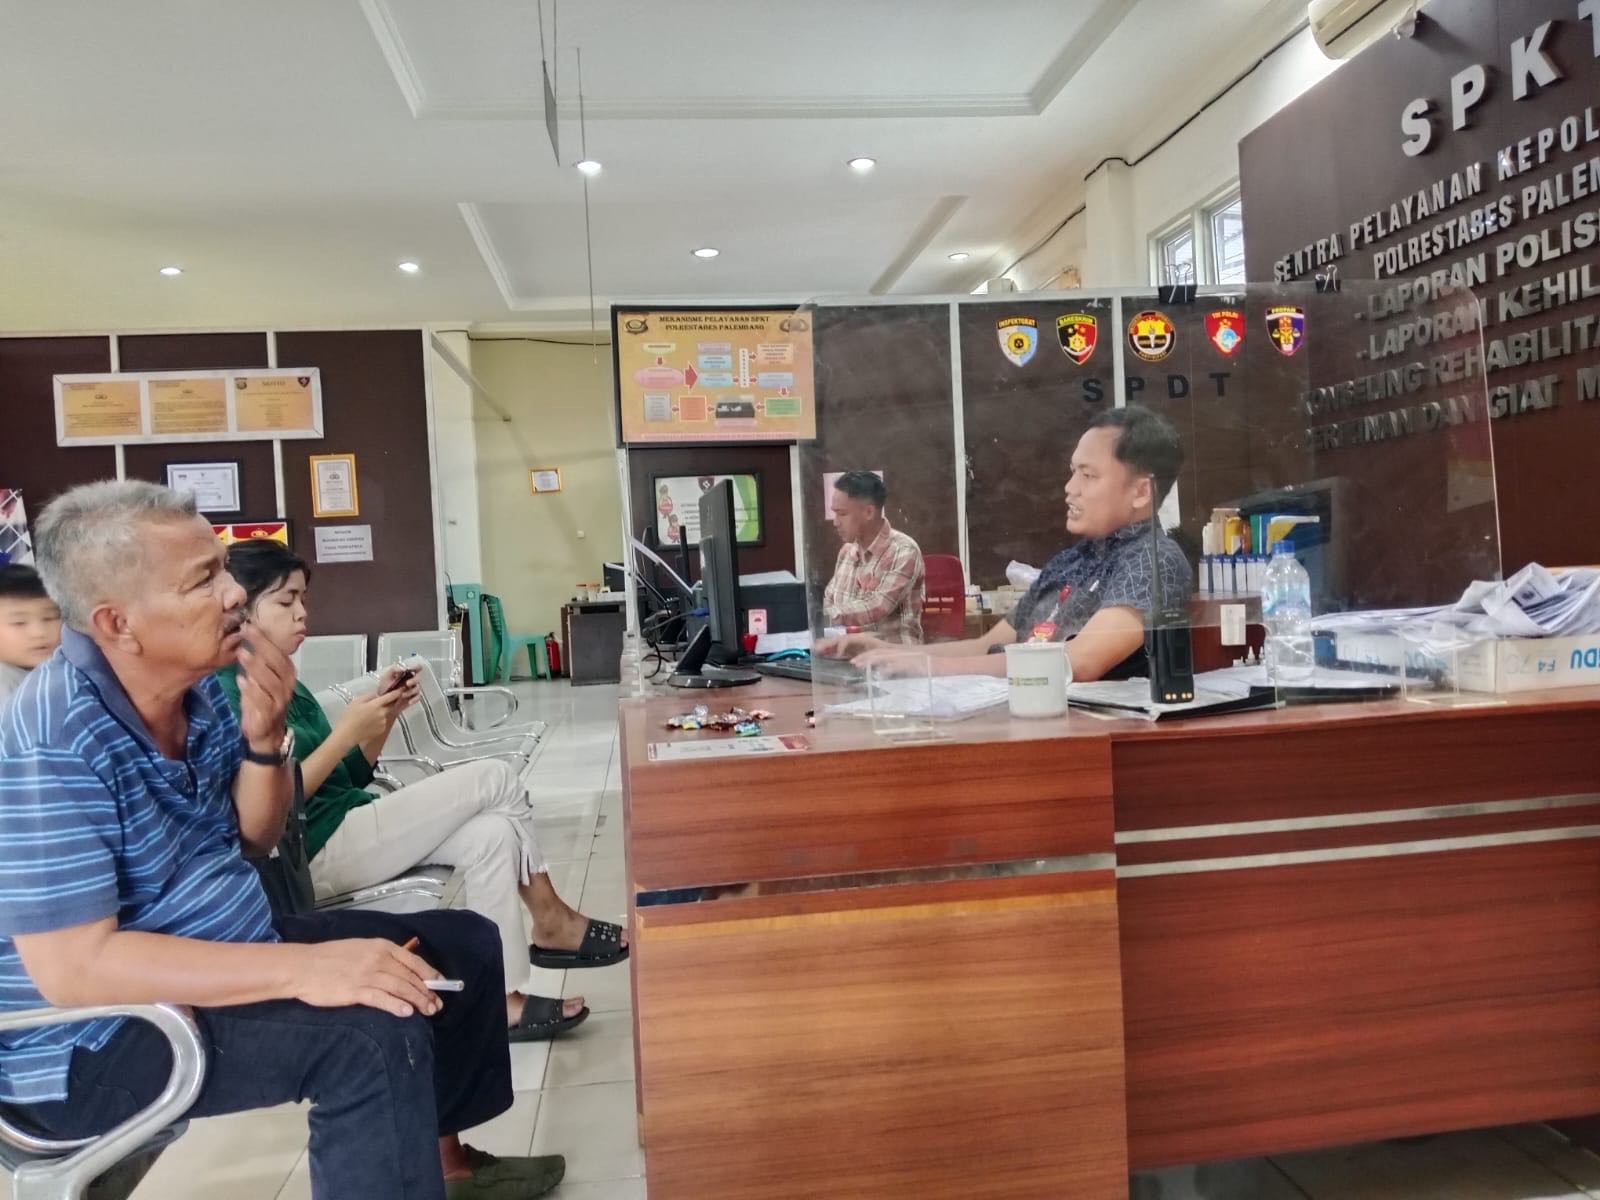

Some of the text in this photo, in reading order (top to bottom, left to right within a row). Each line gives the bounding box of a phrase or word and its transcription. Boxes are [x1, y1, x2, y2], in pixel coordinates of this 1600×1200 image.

[1273, 107, 1600, 286] SENTRA PELAYANAN KEPOL
[1373, 195, 1512, 280] POLRESTABES
[1368, 252, 1486, 320] LAPORAN
[1496, 208, 1600, 276] POLIS
[1369, 297, 1487, 360] LAPORAN
[1498, 263, 1600, 322] KEHIL
[1488, 374, 1558, 418] GIAT
[1570, 647, 1600, 669] DU
